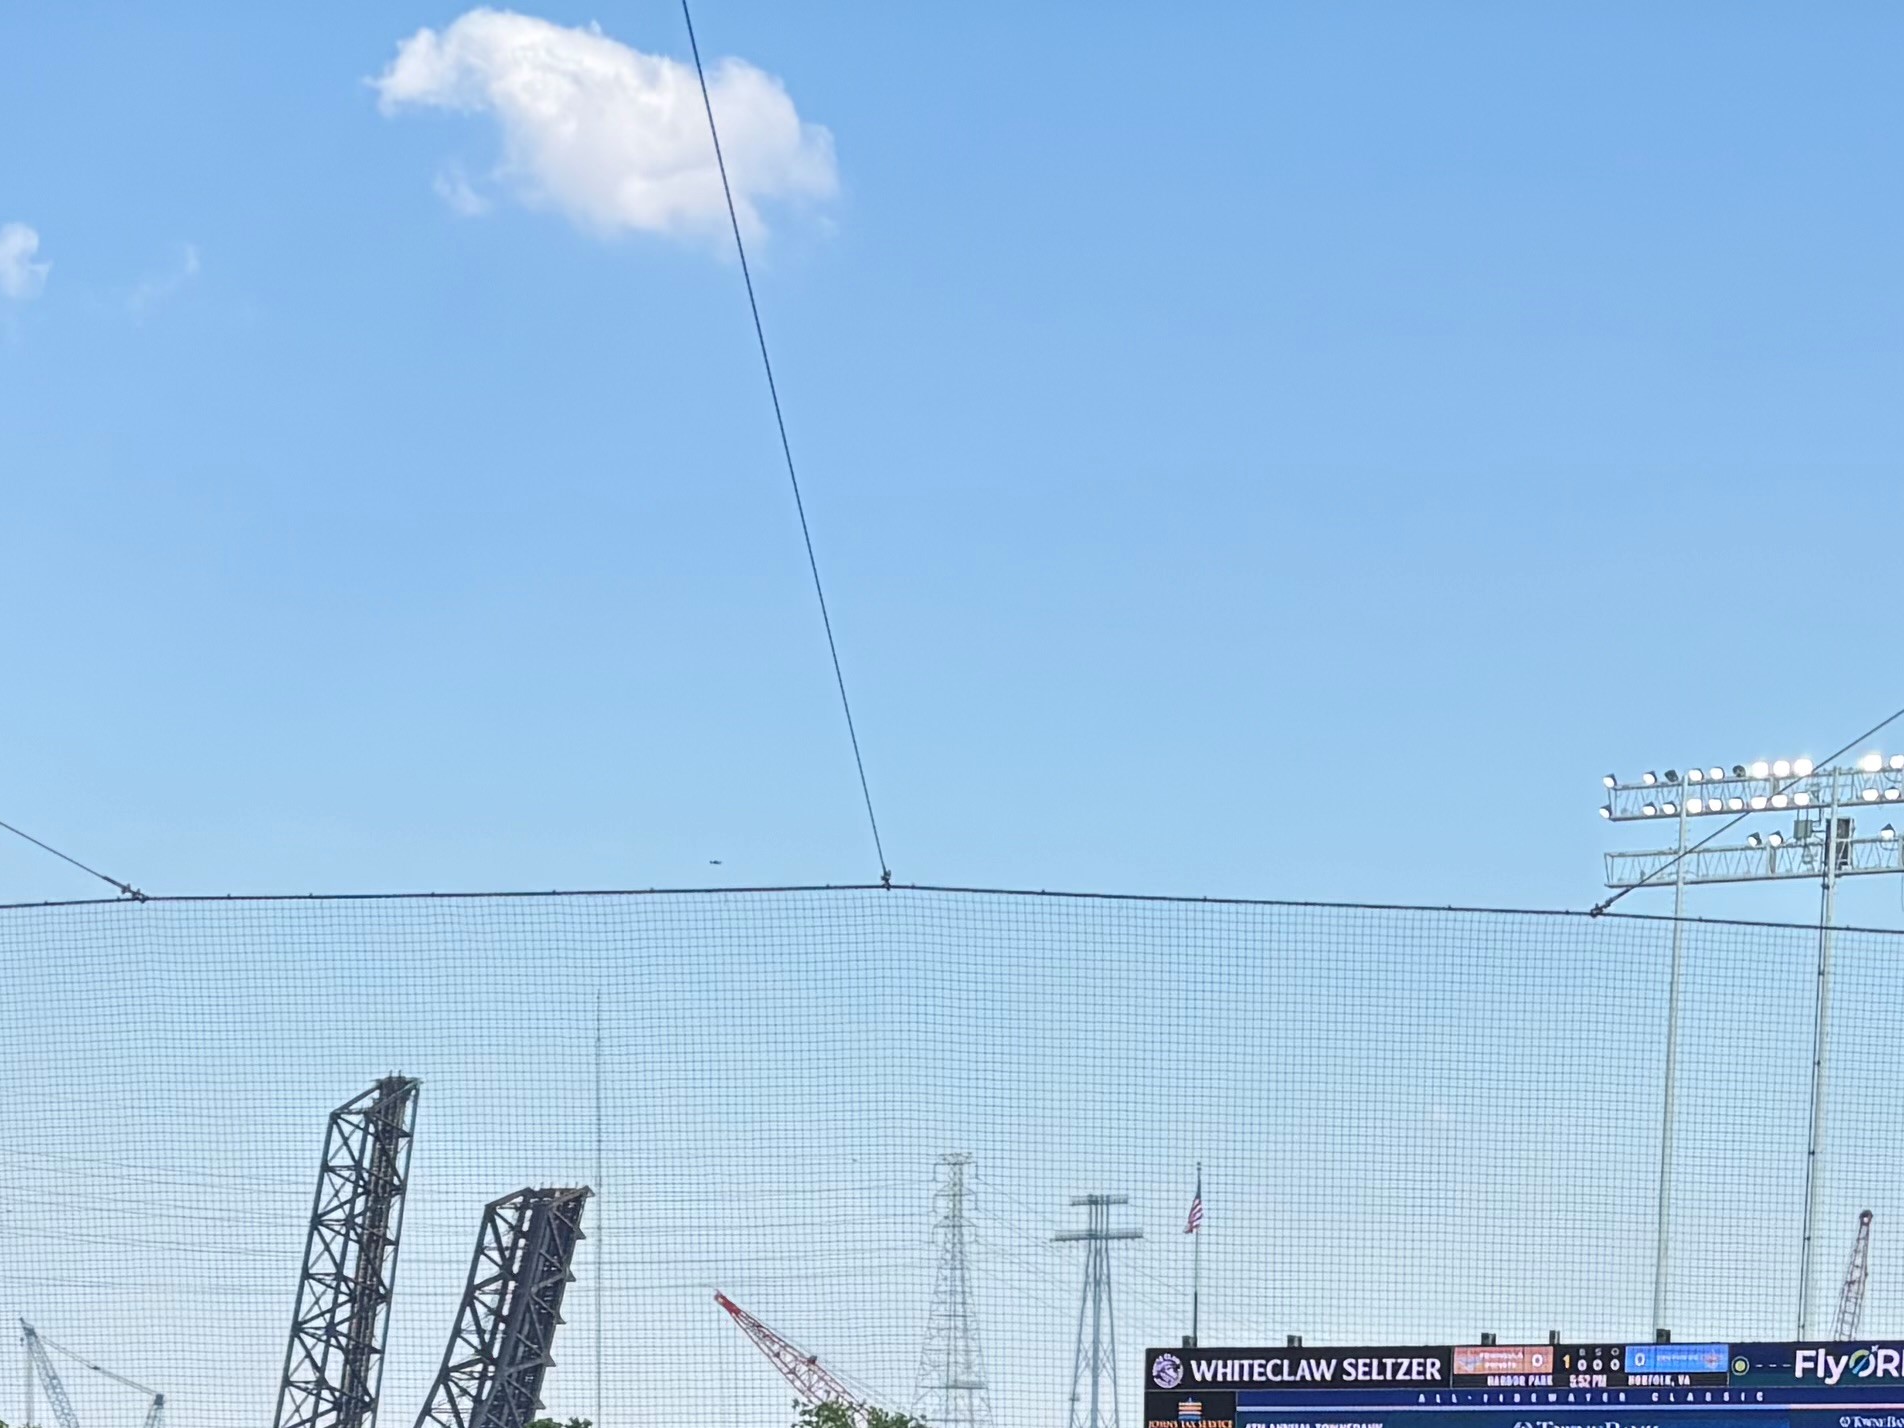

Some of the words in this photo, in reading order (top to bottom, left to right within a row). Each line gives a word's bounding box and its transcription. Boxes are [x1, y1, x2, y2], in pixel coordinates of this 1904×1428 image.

[1562, 1354, 1571, 1369] 1
[1191, 1359, 1337, 1381] WHITECLAW
[1342, 1358, 1441, 1380] SELTZER
[1529, 1375, 1553, 1386] PARK
[1593, 1375, 1607, 1387] PM
[1678, 1375, 1691, 1386] VA
